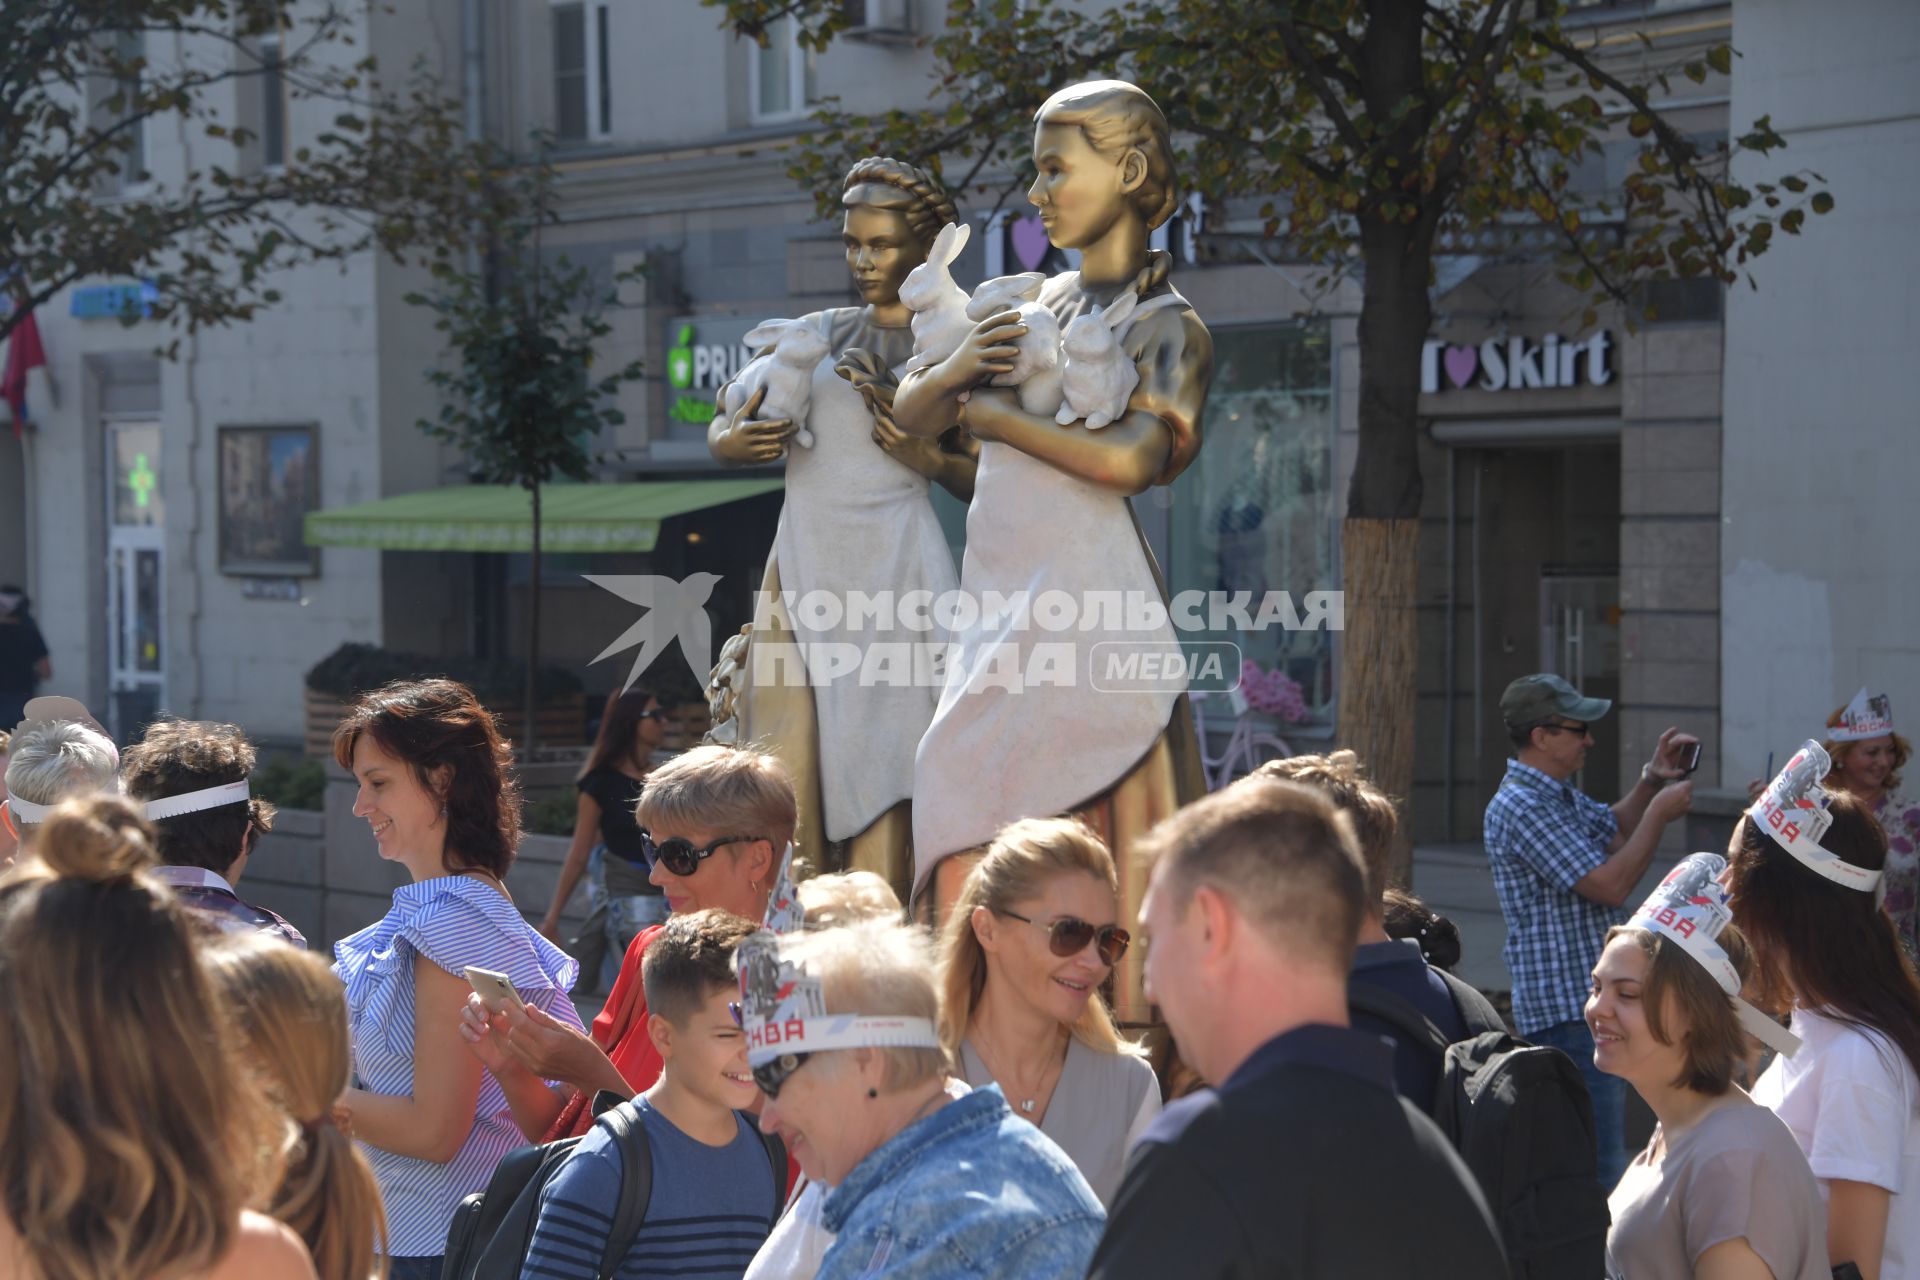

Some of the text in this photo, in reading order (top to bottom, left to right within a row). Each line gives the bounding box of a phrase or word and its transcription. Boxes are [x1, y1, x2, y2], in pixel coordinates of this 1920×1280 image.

[1479, 329, 1611, 391] Skirt
[1848, 720, 1893, 735] МОСК
[1759, 785, 1801, 844] КВА
[1634, 903, 1697, 939] КВА
[745, 1018, 804, 1050] КВА
